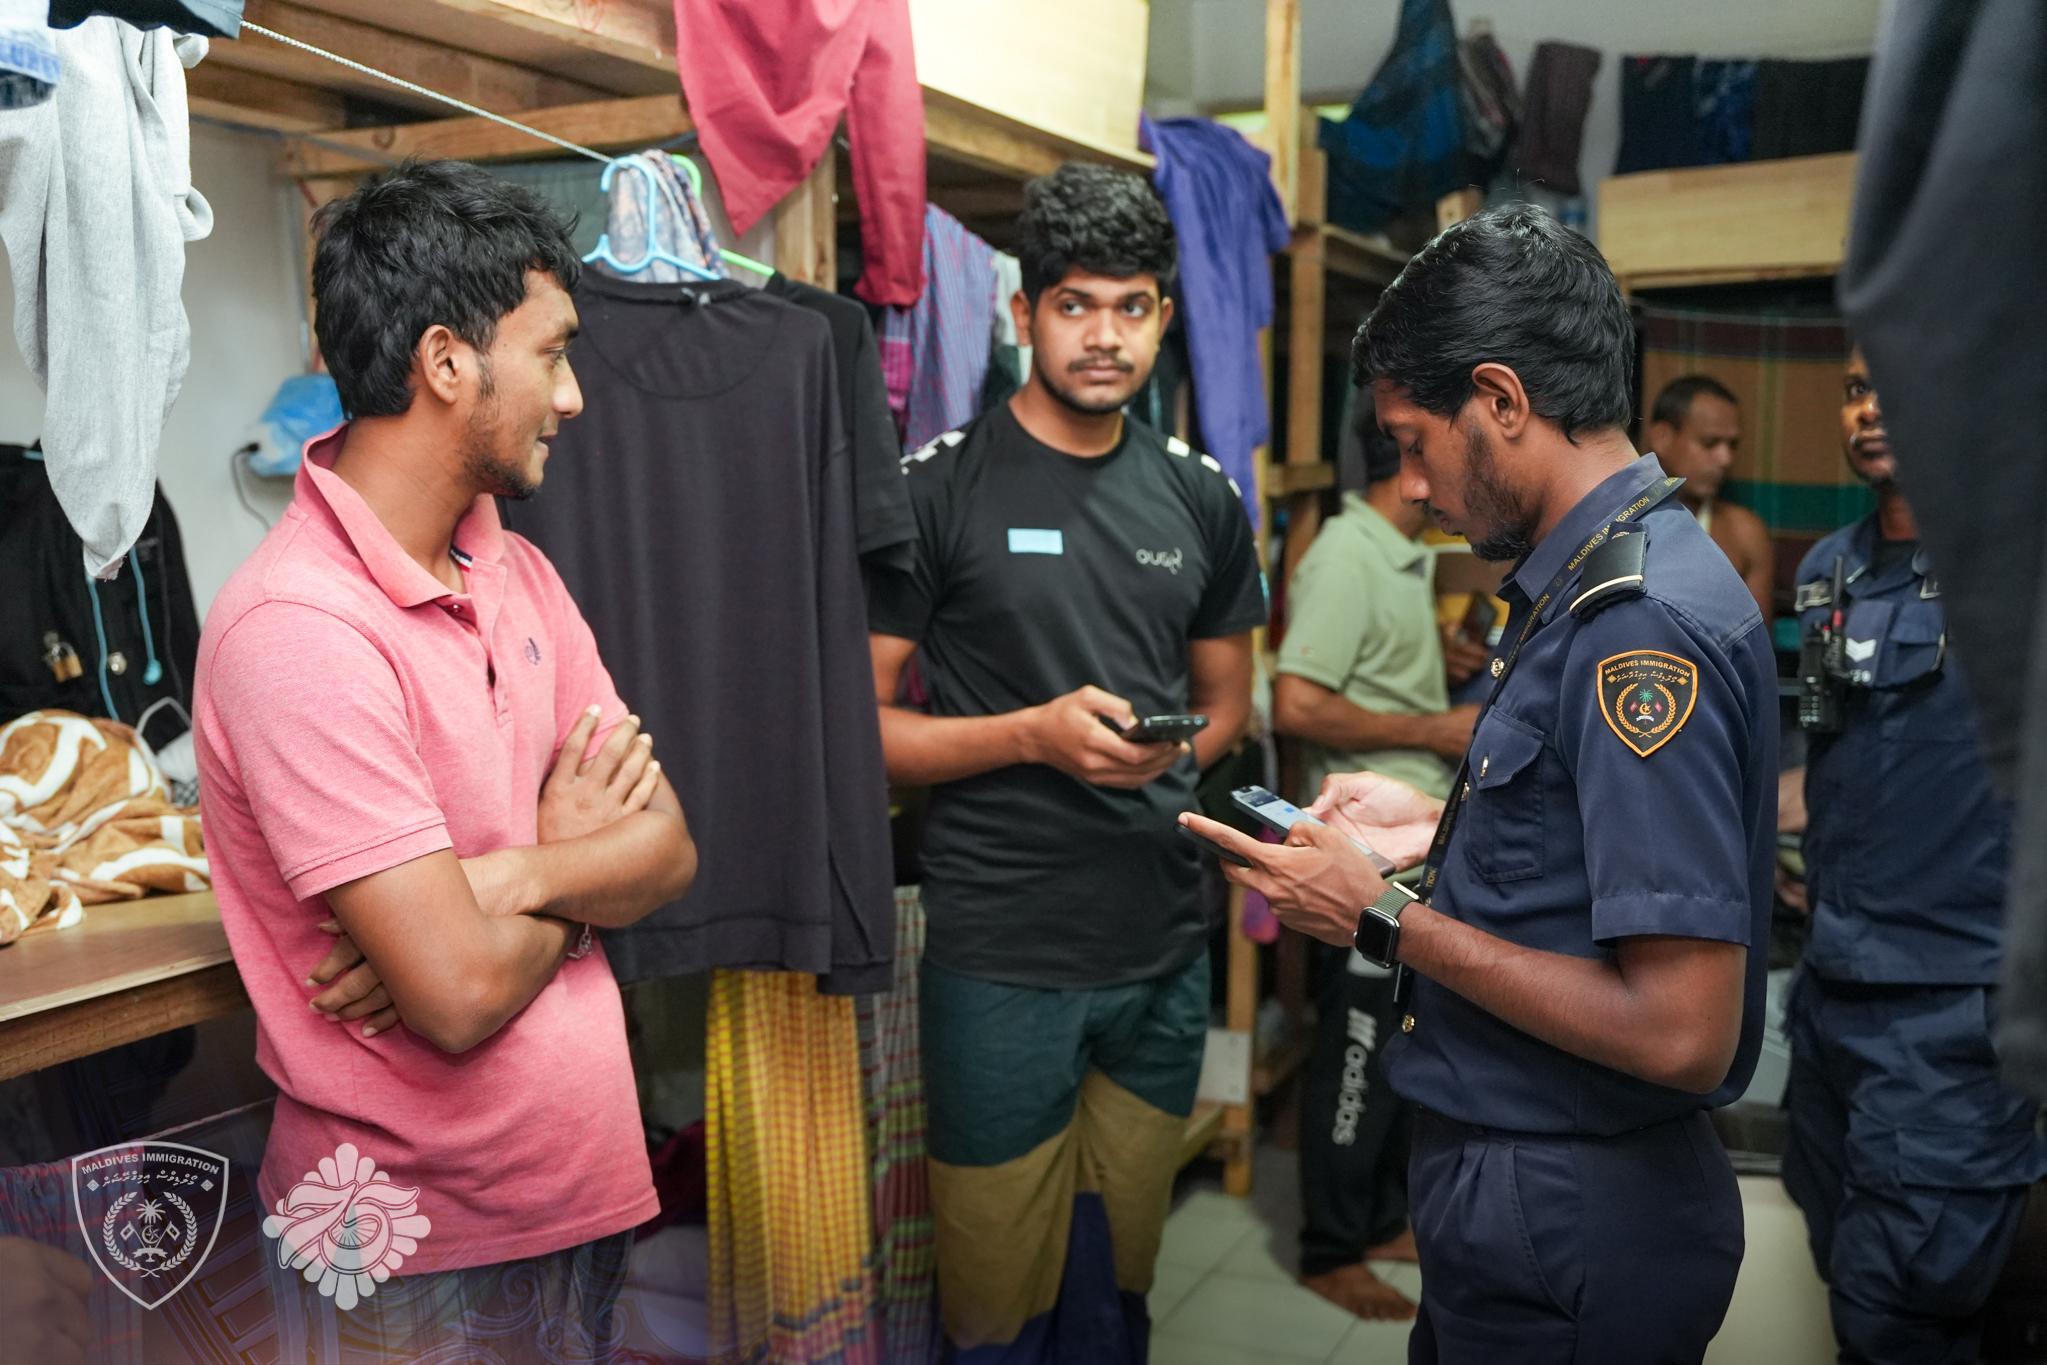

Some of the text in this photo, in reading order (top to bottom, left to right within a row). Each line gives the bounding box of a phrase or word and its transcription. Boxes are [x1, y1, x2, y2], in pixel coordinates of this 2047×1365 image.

[1567, 533, 1604, 571] MALDIVES
[1604, 660, 1691, 678] MALDIVES IMMIGRATION
[1332, 1044, 1369, 1146] adidas
